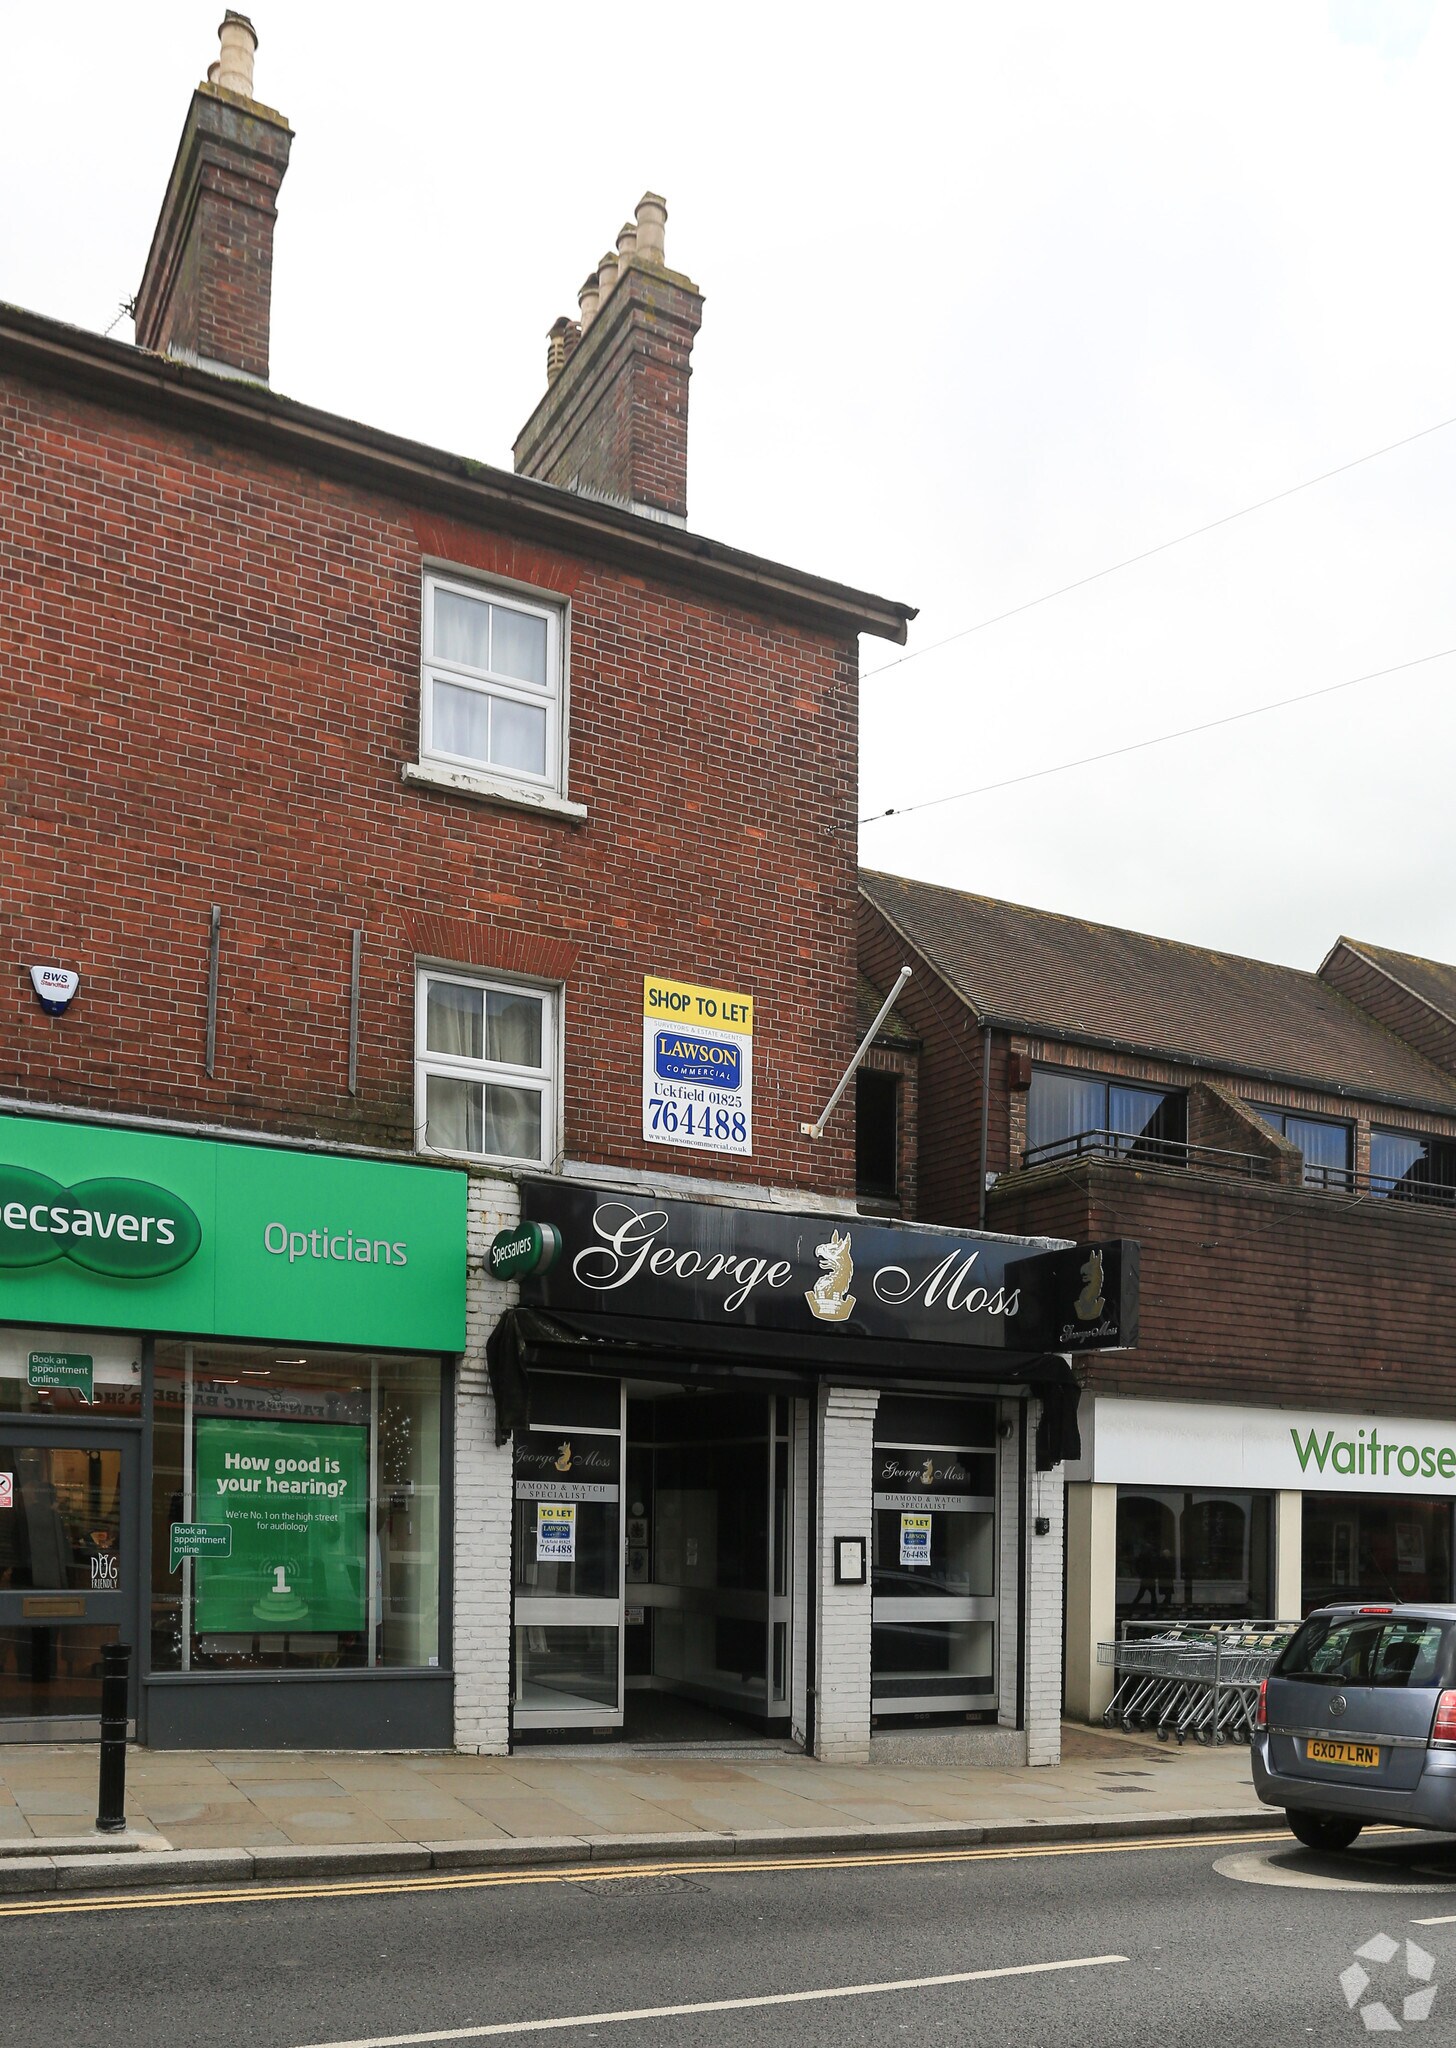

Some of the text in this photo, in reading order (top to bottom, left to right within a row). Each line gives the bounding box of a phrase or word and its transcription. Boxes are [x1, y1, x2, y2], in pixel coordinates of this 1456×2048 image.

[43, 972, 68, 983] BWS
[649, 988, 749, 1023] SHOP TO LET
[654, 1020, 689, 1032] SURVEYORS
[697, 1028, 718, 1038] ESTATE
[720, 1032, 743, 1042] AGENTS
[659, 1038, 738, 1067] LAWSON
[666, 1064, 731, 1081] COMMERCIAL
[654, 1082, 742, 1108] Uckfield 01825
[648, 1098, 747, 1143] 764488
[648, 1133, 748, 1153] www.lawsoncommercial.co.uk
[0, 1202, 175, 1245] ecsavers
[264, 1222, 408, 1266] Opticians
[492, 1236, 532, 1267] Specsavers
[573, 1202, 1022, 1318] George Moss
[32, 1355, 67, 1365] Book an
[32, 1365, 89, 1375] appointment
[32, 1375, 60, 1384] online
[515, 1444, 611, 1469] George Moss
[1290, 1428, 1456, 1479] Waitrose
[225, 1452, 340, 1474] How good is
[881, 1460, 965, 1483] George Moss
[216, 1478, 262, 1495] your
[266, 1476, 348, 1498] hearing?
[516, 1482, 557, 1491] IAMOND
[572, 1485, 606, 1493] WATCH
[529, 1492, 587, 1500] SPECIALIST
[885, 1494, 923, 1502] DIAMOND
[934, 1496, 962, 1504] WATCH
[541, 1509, 573, 1518] TO LET
[900, 1502, 947, 1510] SPECIALIST
[225, 1510, 249, 1519] We're
[250, 1511, 264, 1520] No.
[281, 1512, 295, 1521] the
[296, 1512, 314, 1523] high
[315, 1513, 338, 1522] street
[915, 1519, 929, 1527] LET
[174, 1526, 196, 1535] Book
[256, 1522, 309, 1533] for audiology
[174, 1536, 226, 1545] appointment
[539, 1544, 573, 1554] 764488
[174, 1545, 200, 1554] online
[902, 1550, 928, 1559] 764488
[91, 1552, 118, 1579] DOG
[91, 1579, 118, 1589] FRIENDLY
[272, 1565, 291, 1593] 1
[1313, 1743, 1374, 1763] GX07 LRN
